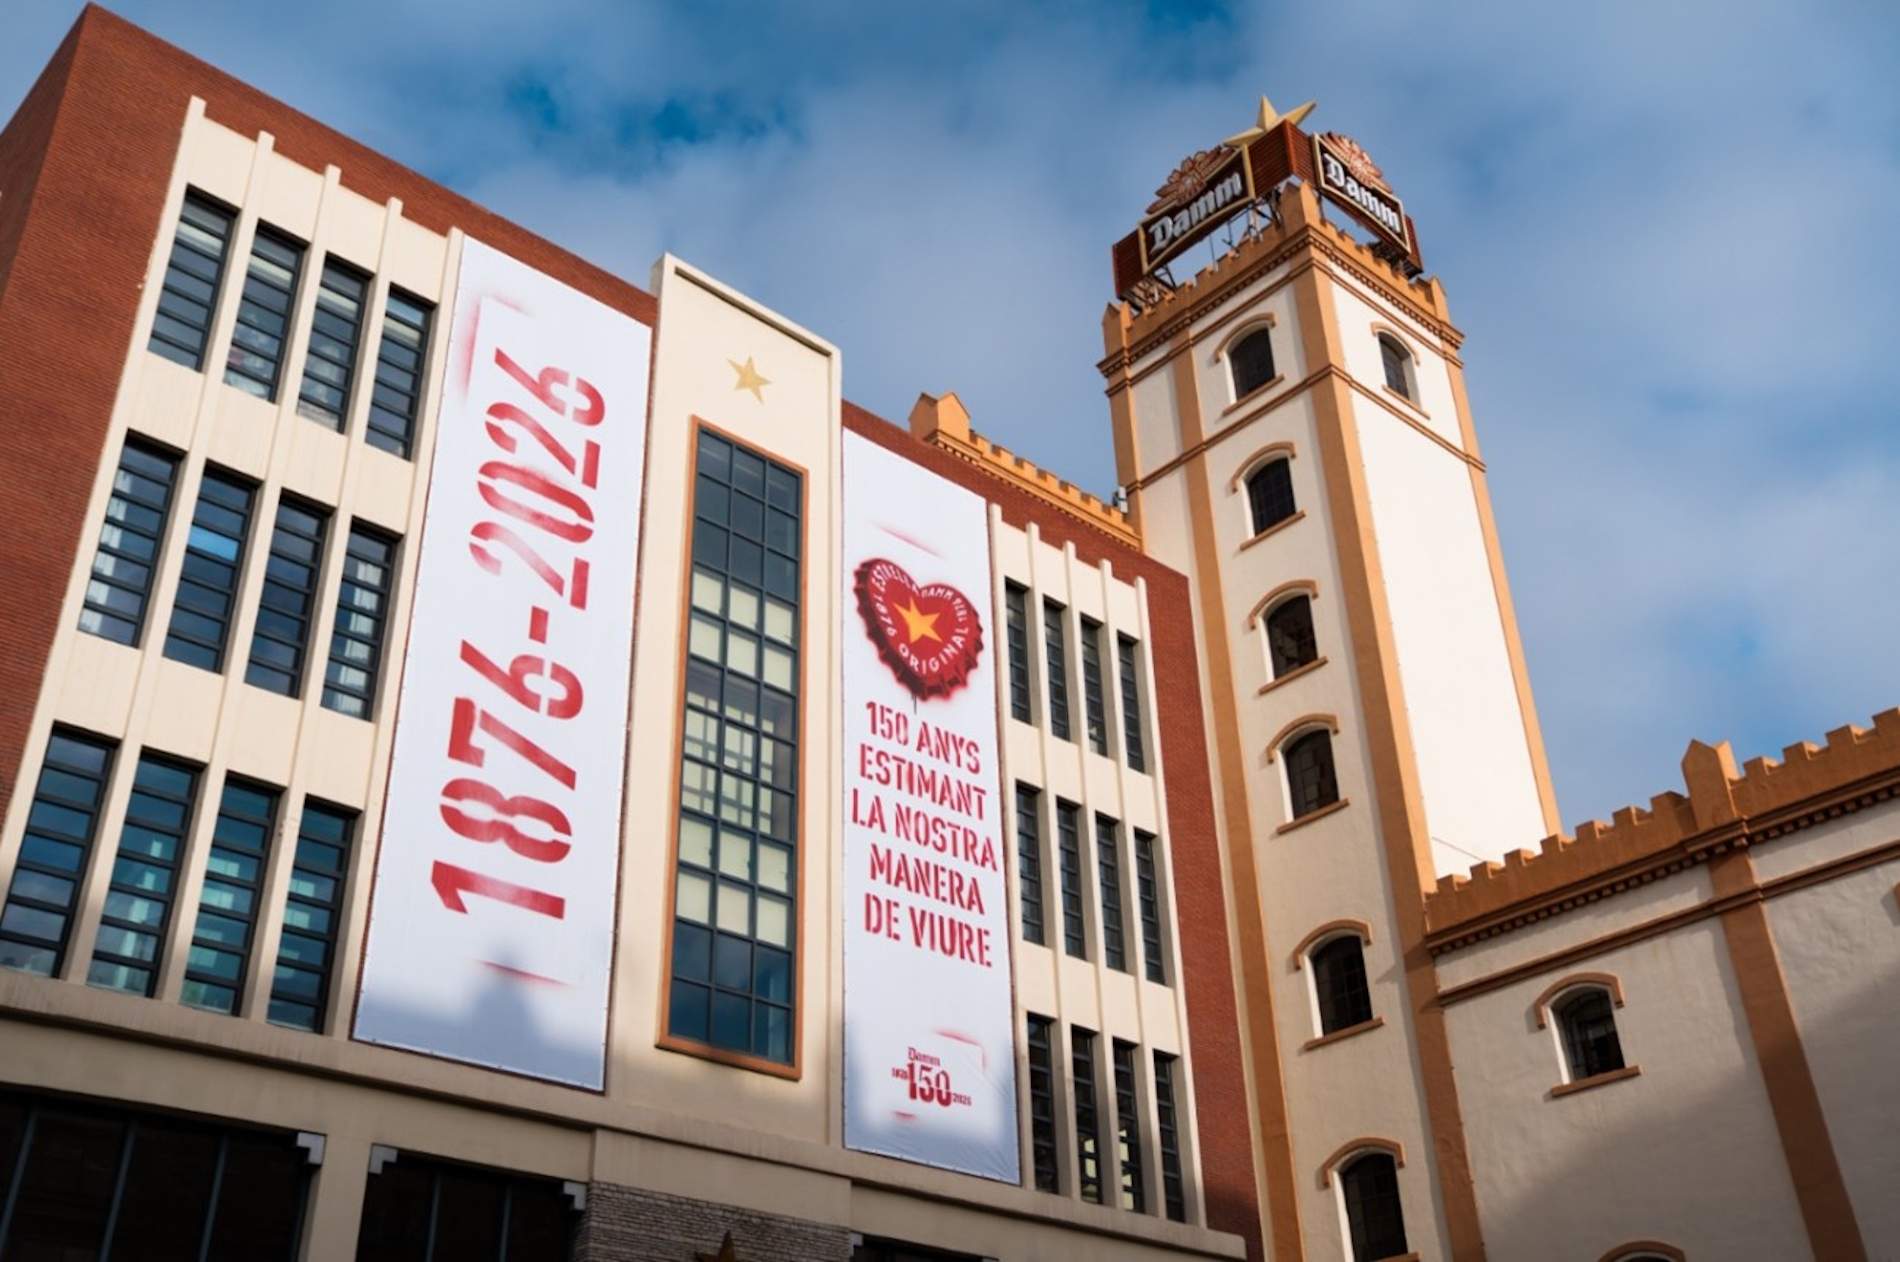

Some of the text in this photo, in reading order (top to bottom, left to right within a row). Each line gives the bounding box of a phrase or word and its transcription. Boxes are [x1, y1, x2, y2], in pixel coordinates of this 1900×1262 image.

[1149, 172, 1242, 250] Damm
[1323, 153, 1400, 233] Damm
[431, 347, 606, 921] 1876-2026
[899, 626, 969, 674] ORIGINAL
[866, 701, 980, 775] 150 ANYS
[860, 743, 986, 821] ESTIMANT
[852, 788, 998, 872] LA NOSTRA
[870, 843, 985, 916] MANERA
[864, 892, 992, 968] DE VIURE
[907, 1062, 951, 1107] 150
